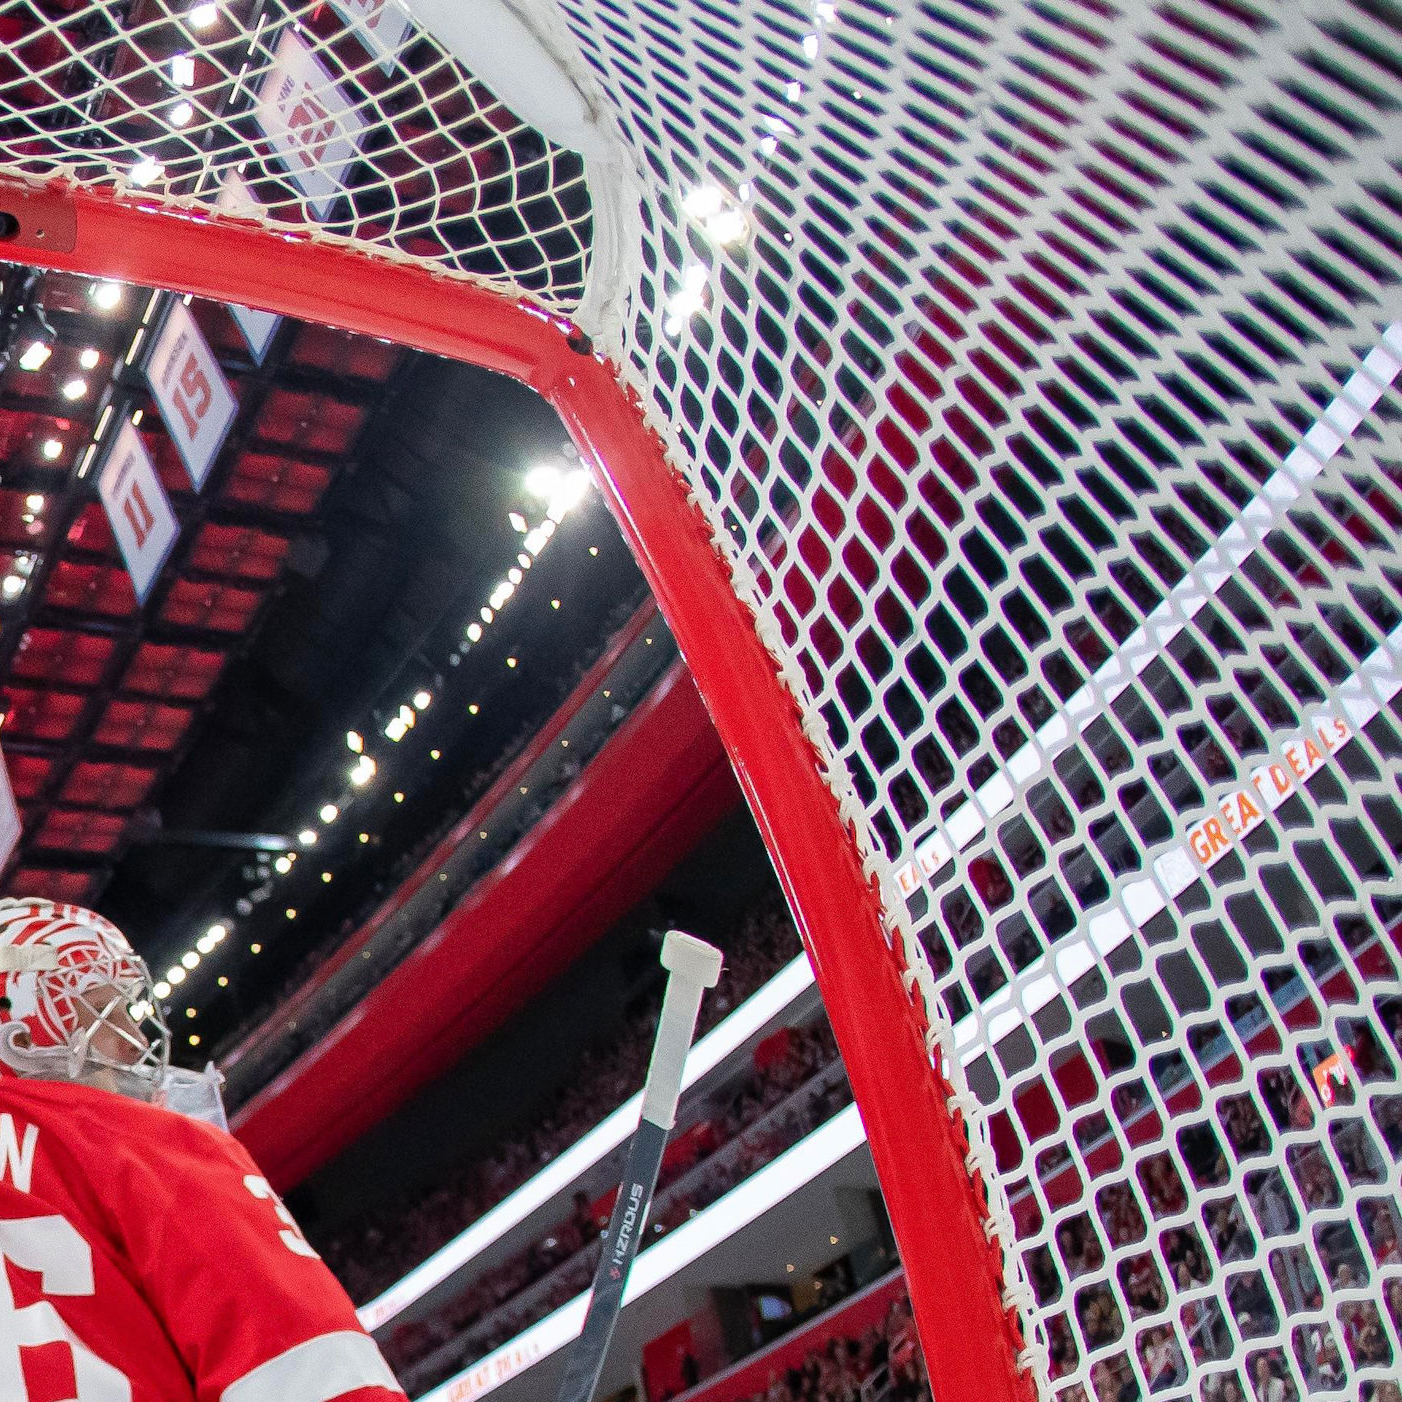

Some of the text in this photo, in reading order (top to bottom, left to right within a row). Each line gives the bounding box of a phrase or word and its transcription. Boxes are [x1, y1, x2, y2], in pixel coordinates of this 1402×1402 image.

[172, 351, 213, 442] 15
[122, 480, 155, 549] 11
[1268, 718, 1348, 797] DEALS
